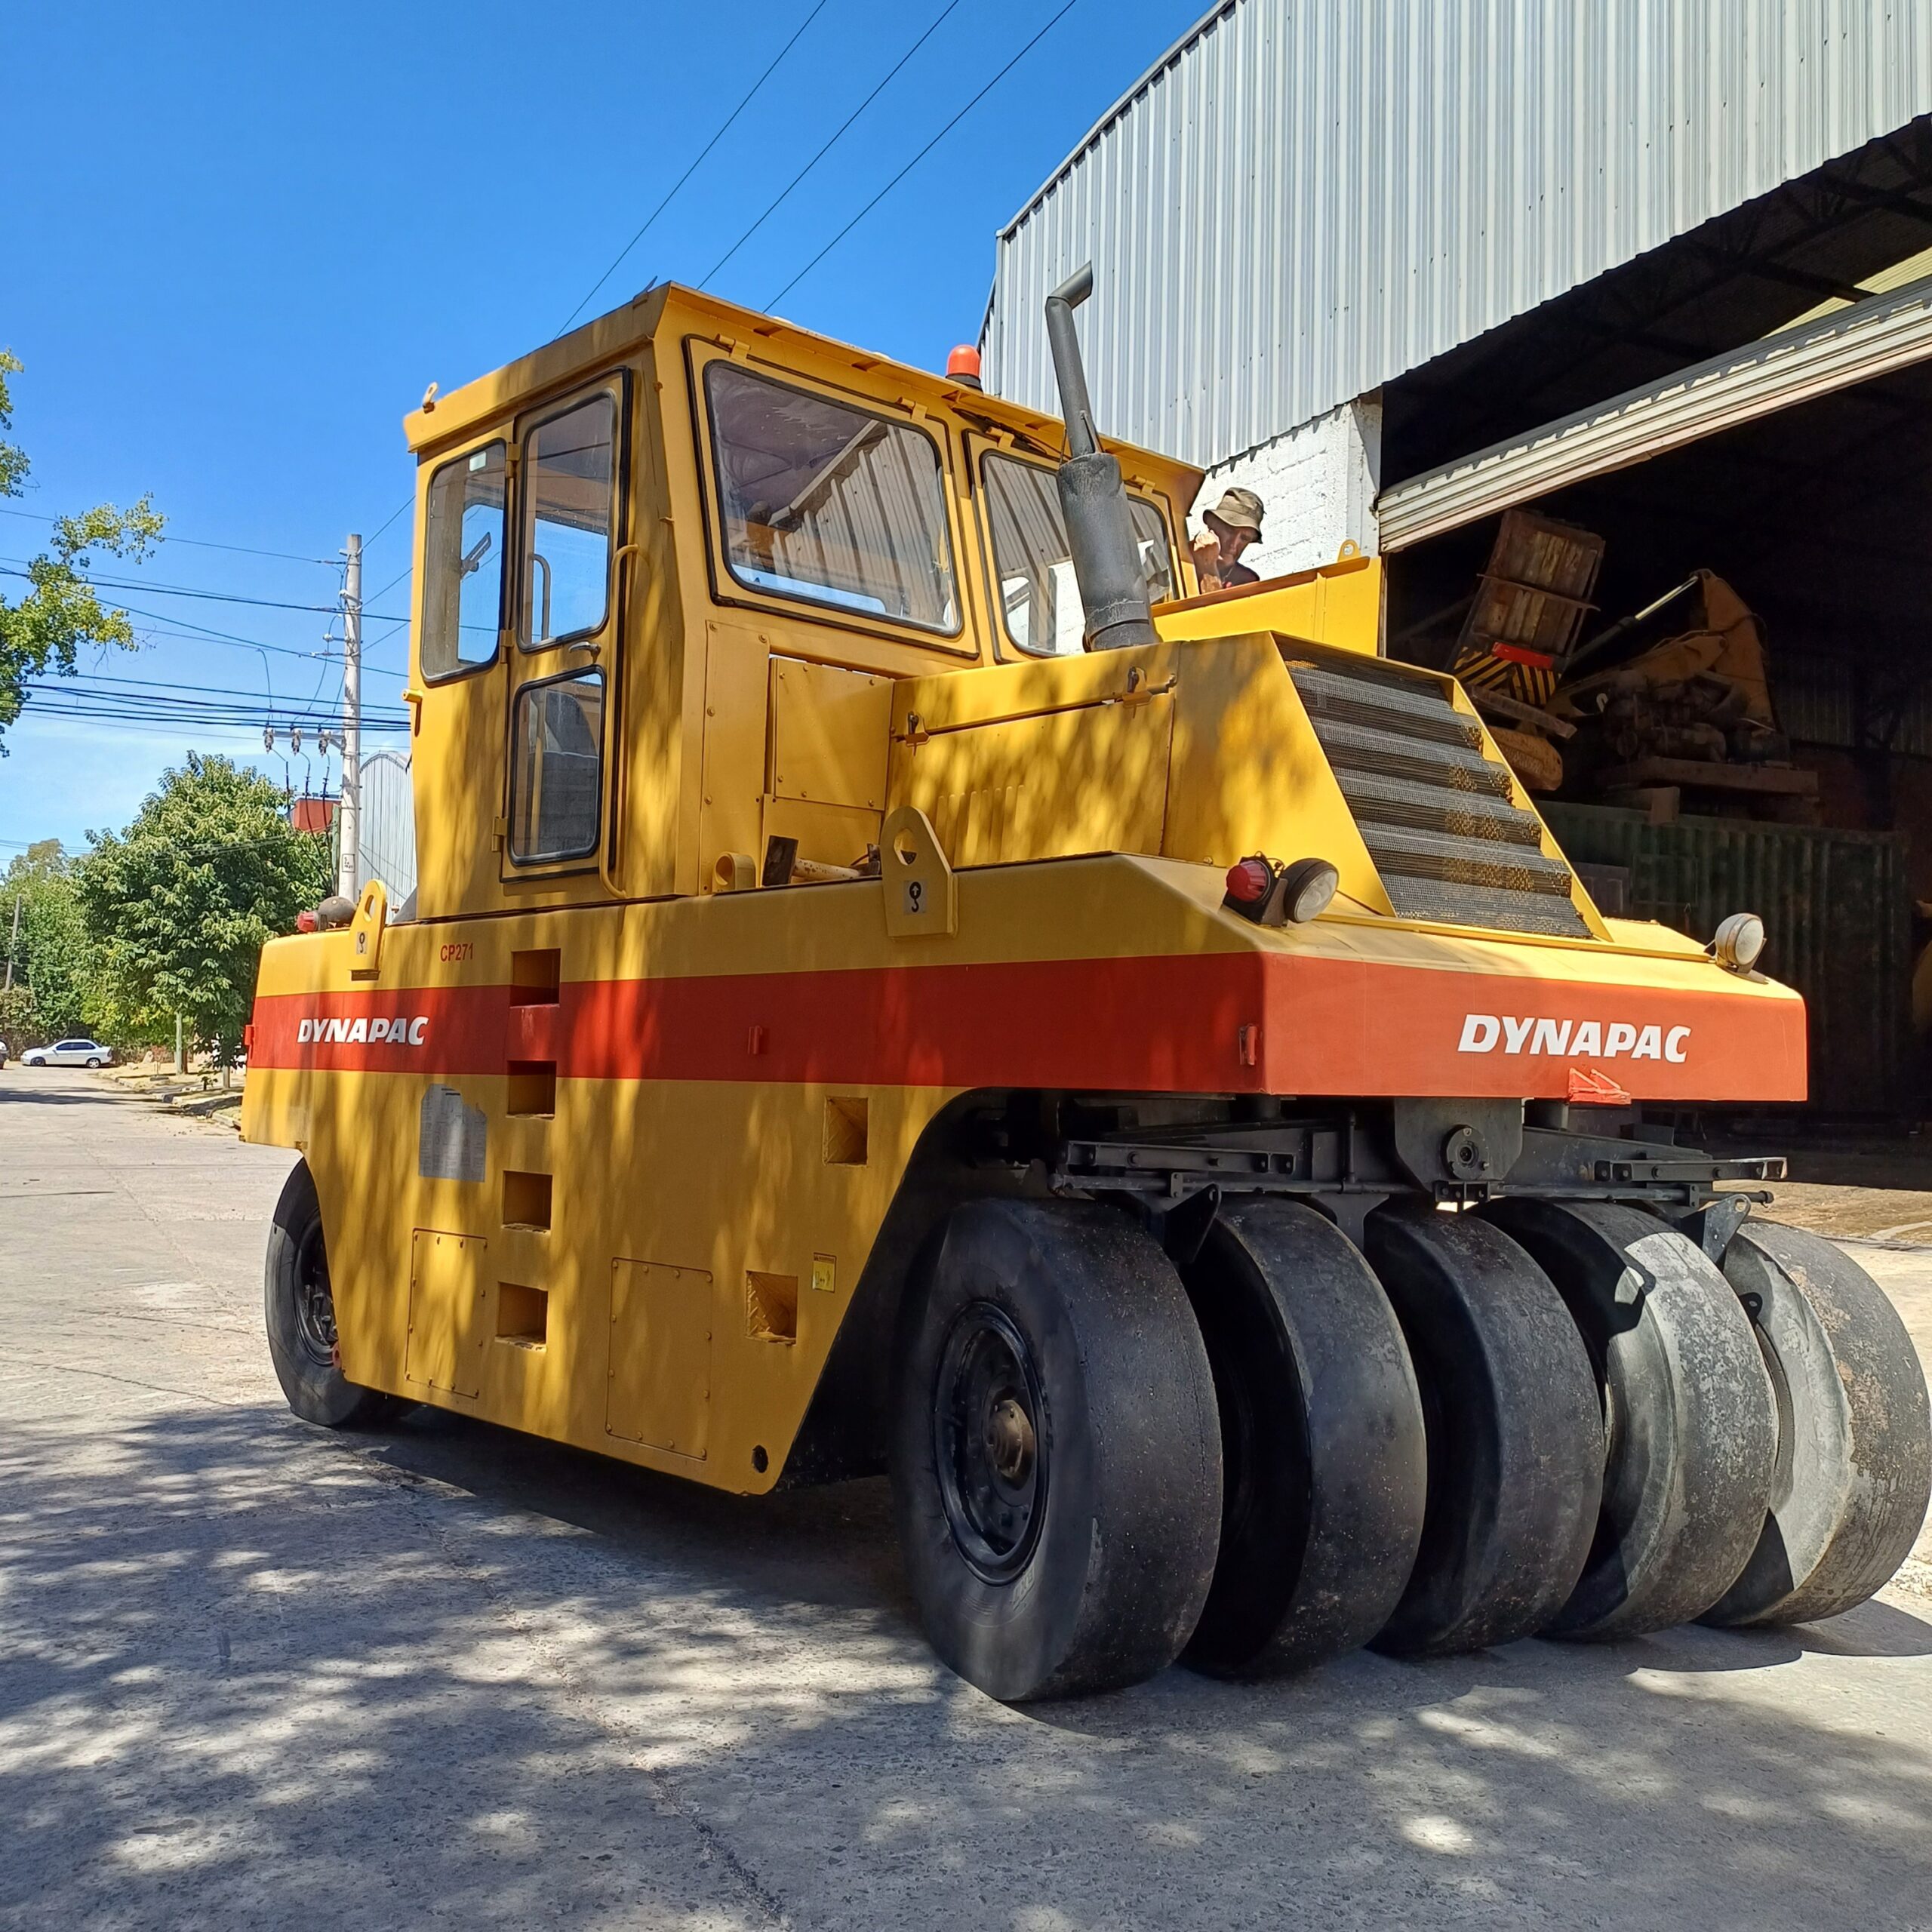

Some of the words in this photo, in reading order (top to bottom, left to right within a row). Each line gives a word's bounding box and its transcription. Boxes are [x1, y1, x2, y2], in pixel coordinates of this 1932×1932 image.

[440, 942, 474, 962] CP271
[297, 1016, 429, 1046] DYNAPAC
[1457, 1014, 1691, 1063] DYNAPAC
